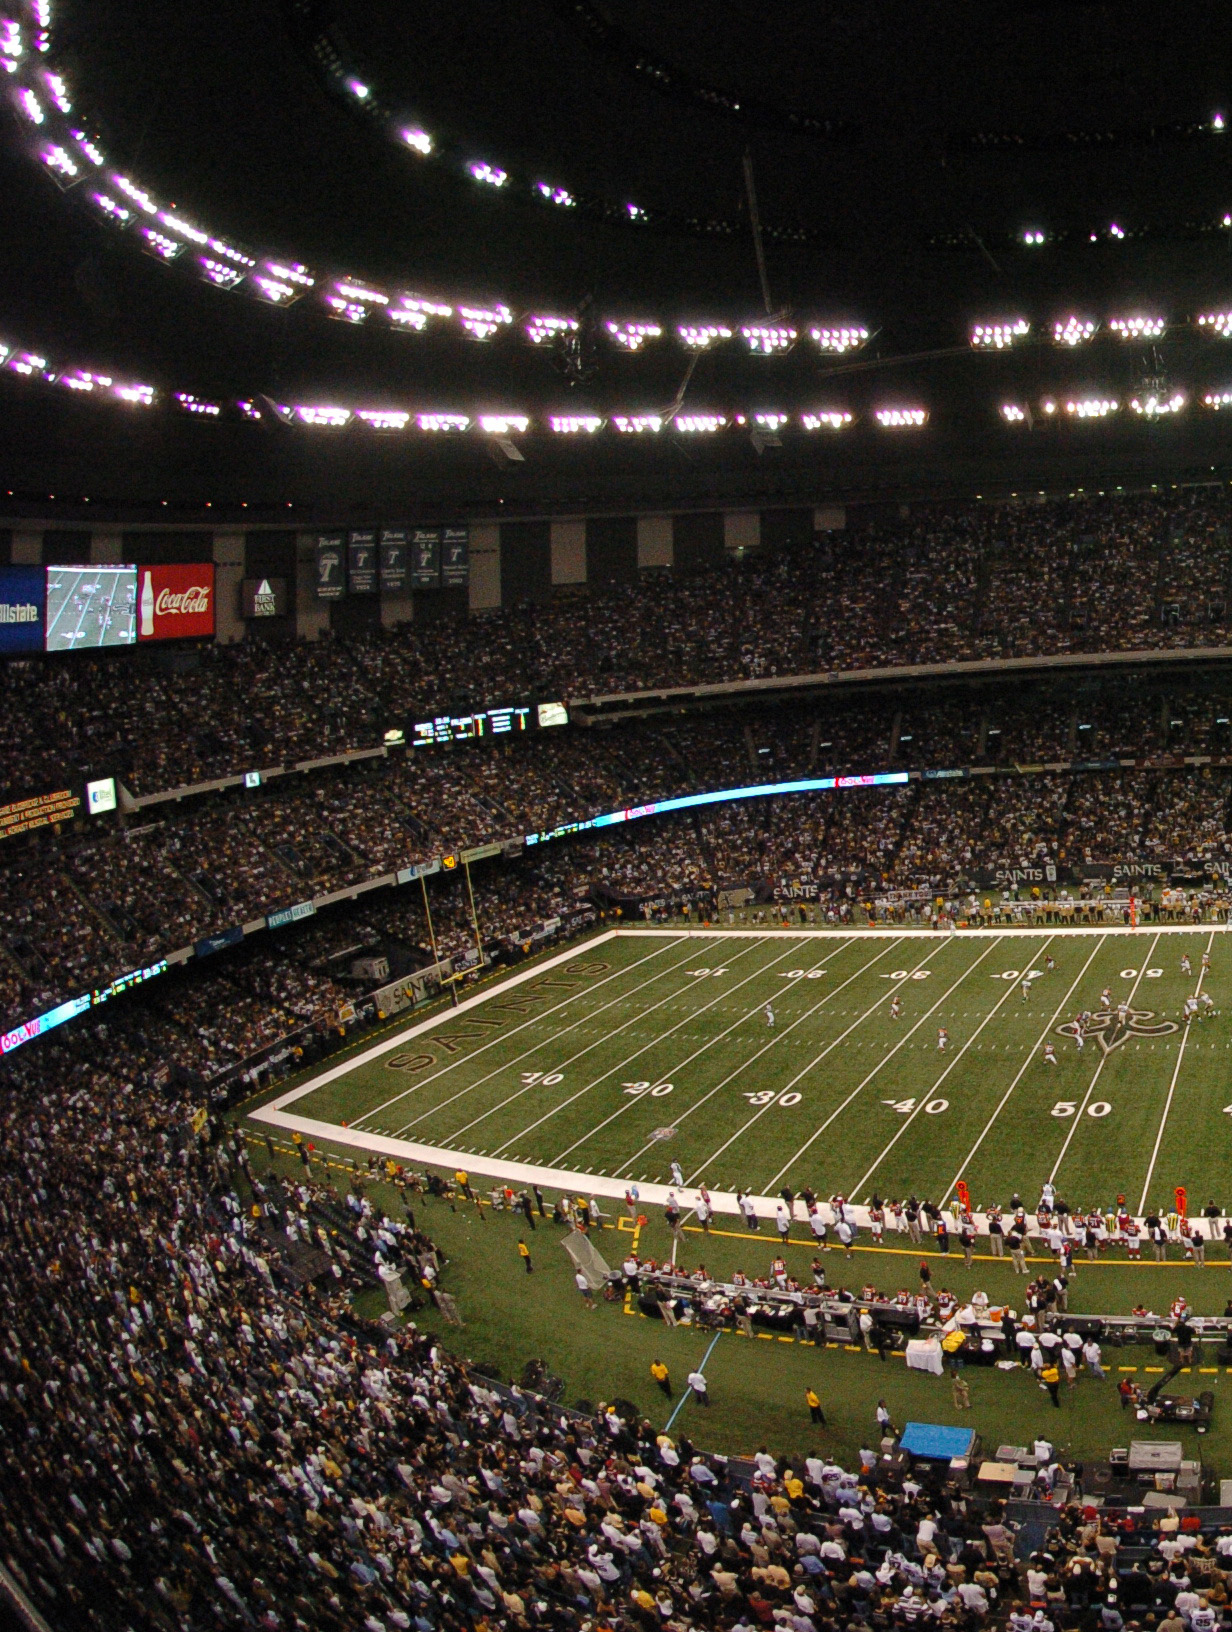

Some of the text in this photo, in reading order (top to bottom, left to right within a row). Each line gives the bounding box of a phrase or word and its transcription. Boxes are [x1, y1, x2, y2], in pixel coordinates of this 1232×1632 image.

[996, 869, 1043, 881] SAINTS
[1113, 864, 1162, 877] SAINTS
[773, 885, 819, 899] SAINTS
[692, 967, 730, 977] 10
[787, 968, 828, 979] 20
[890, 970, 932, 980] 30
[1001, 969, 1044, 980] 40
[1120, 968, 1163, 978] 50
[384, 961, 612, 1074] SAINTS
[525, 1071, 564, 1086] 10
[626, 1081, 674, 1097] 20
[750, 1090, 803, 1106] 30
[890, 1098, 949, 1114] 40
[1050, 1101, 1112, 1117] 50
[1195, 1618, 1211, 1627] 25
